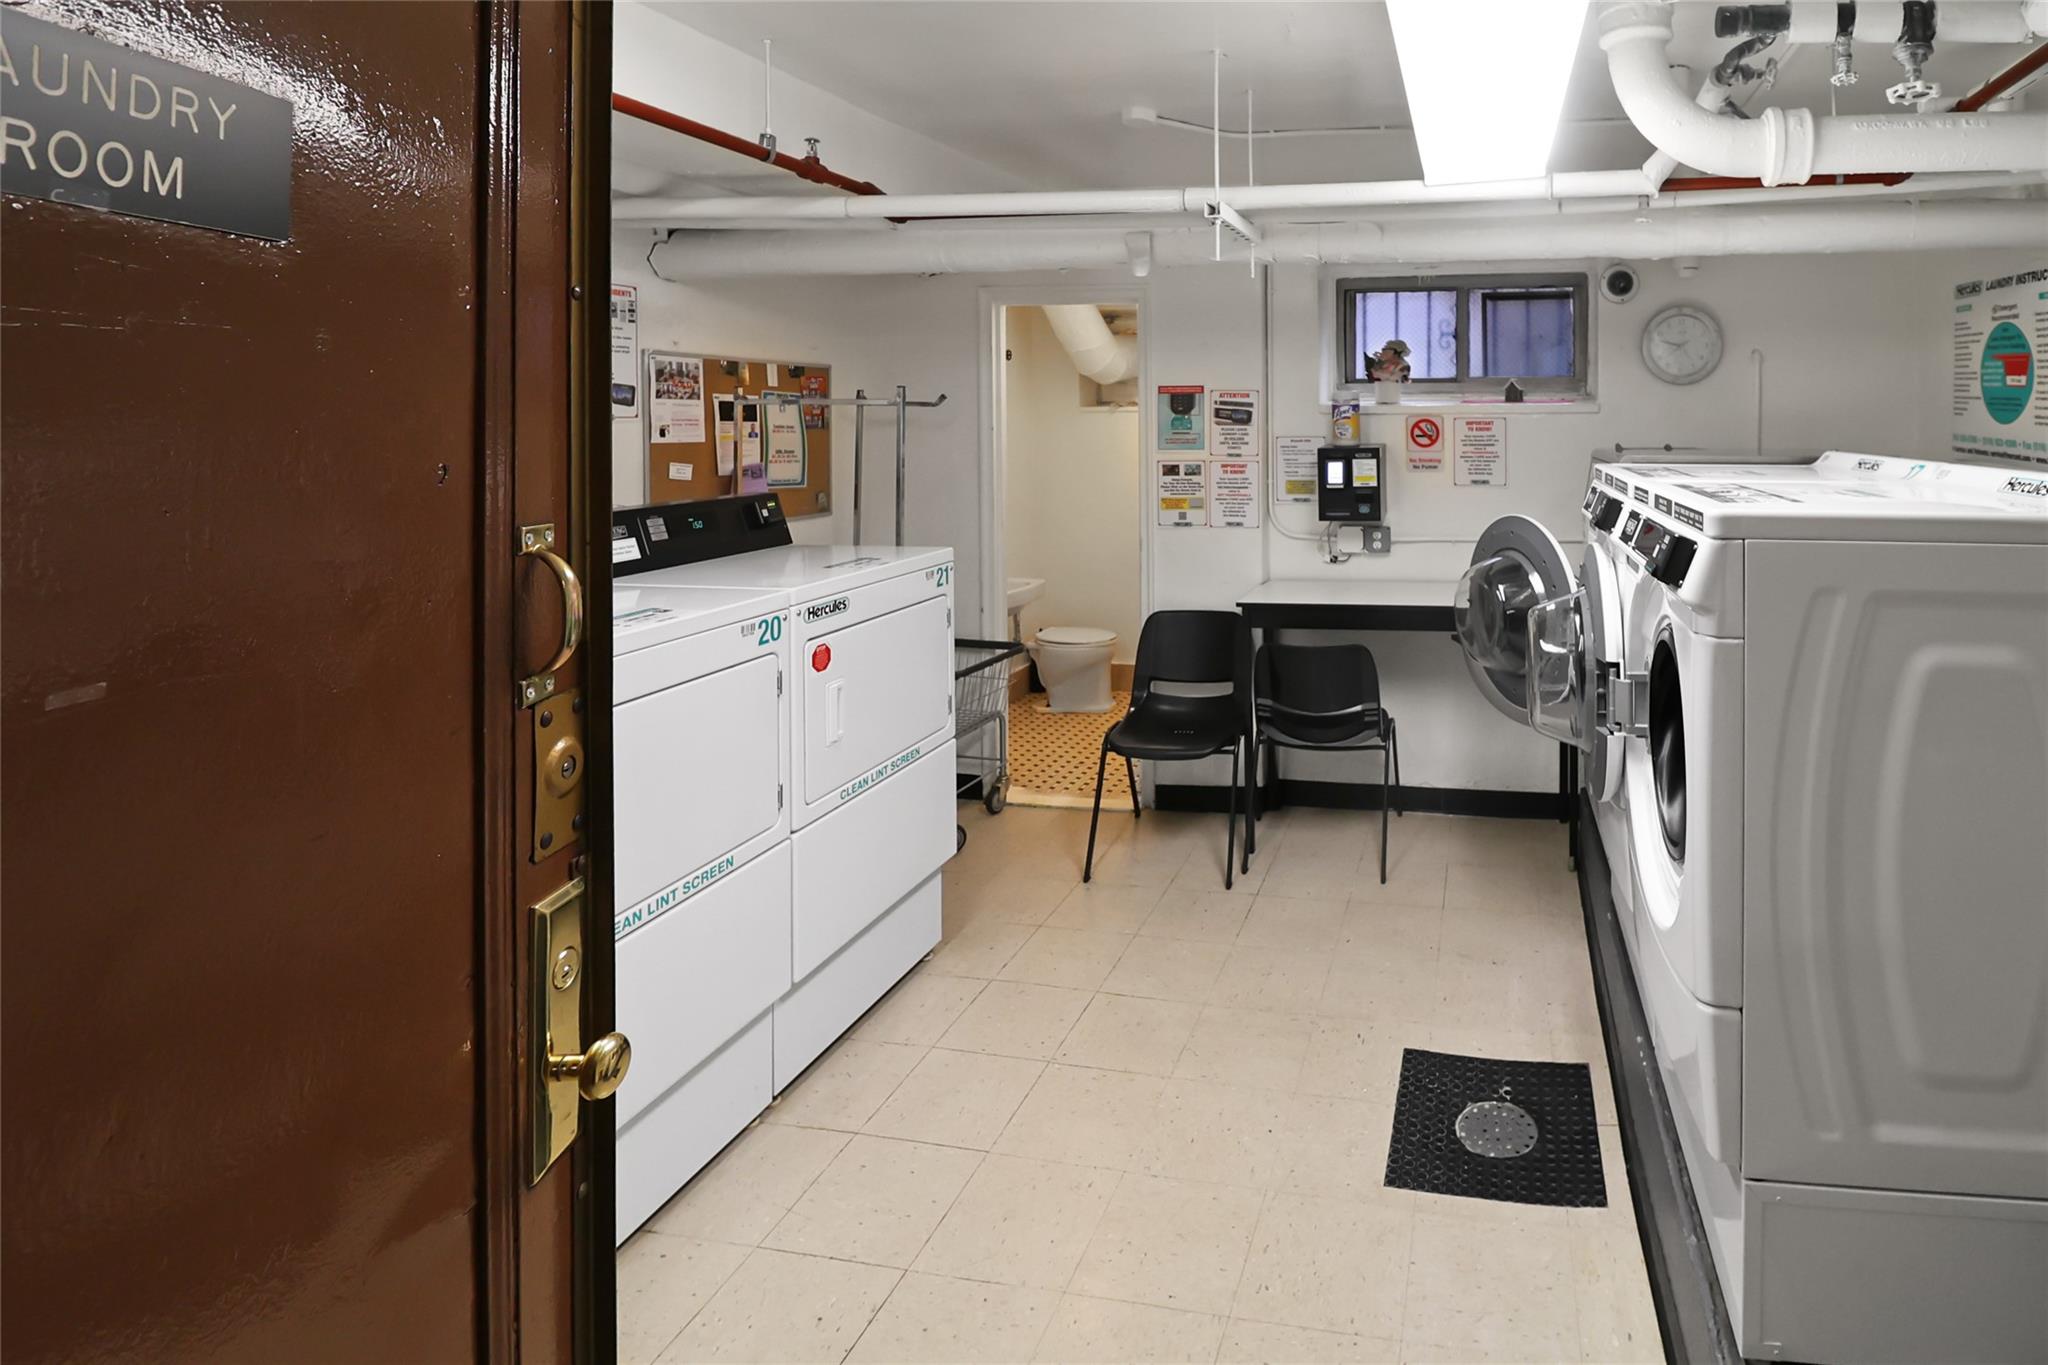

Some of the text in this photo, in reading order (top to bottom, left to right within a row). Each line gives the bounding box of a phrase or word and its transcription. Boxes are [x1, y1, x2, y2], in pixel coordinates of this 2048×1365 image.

[0, 115, 184, 200] ROOM
[936, 567, 950, 588] 21
[757, 615, 782, 647] 20
[807, 598, 848, 621] Hercules
[840, 747, 921, 801] CLEAN LINT SCREEN
[614, 855, 735, 935] EAN LINT SCREEN
